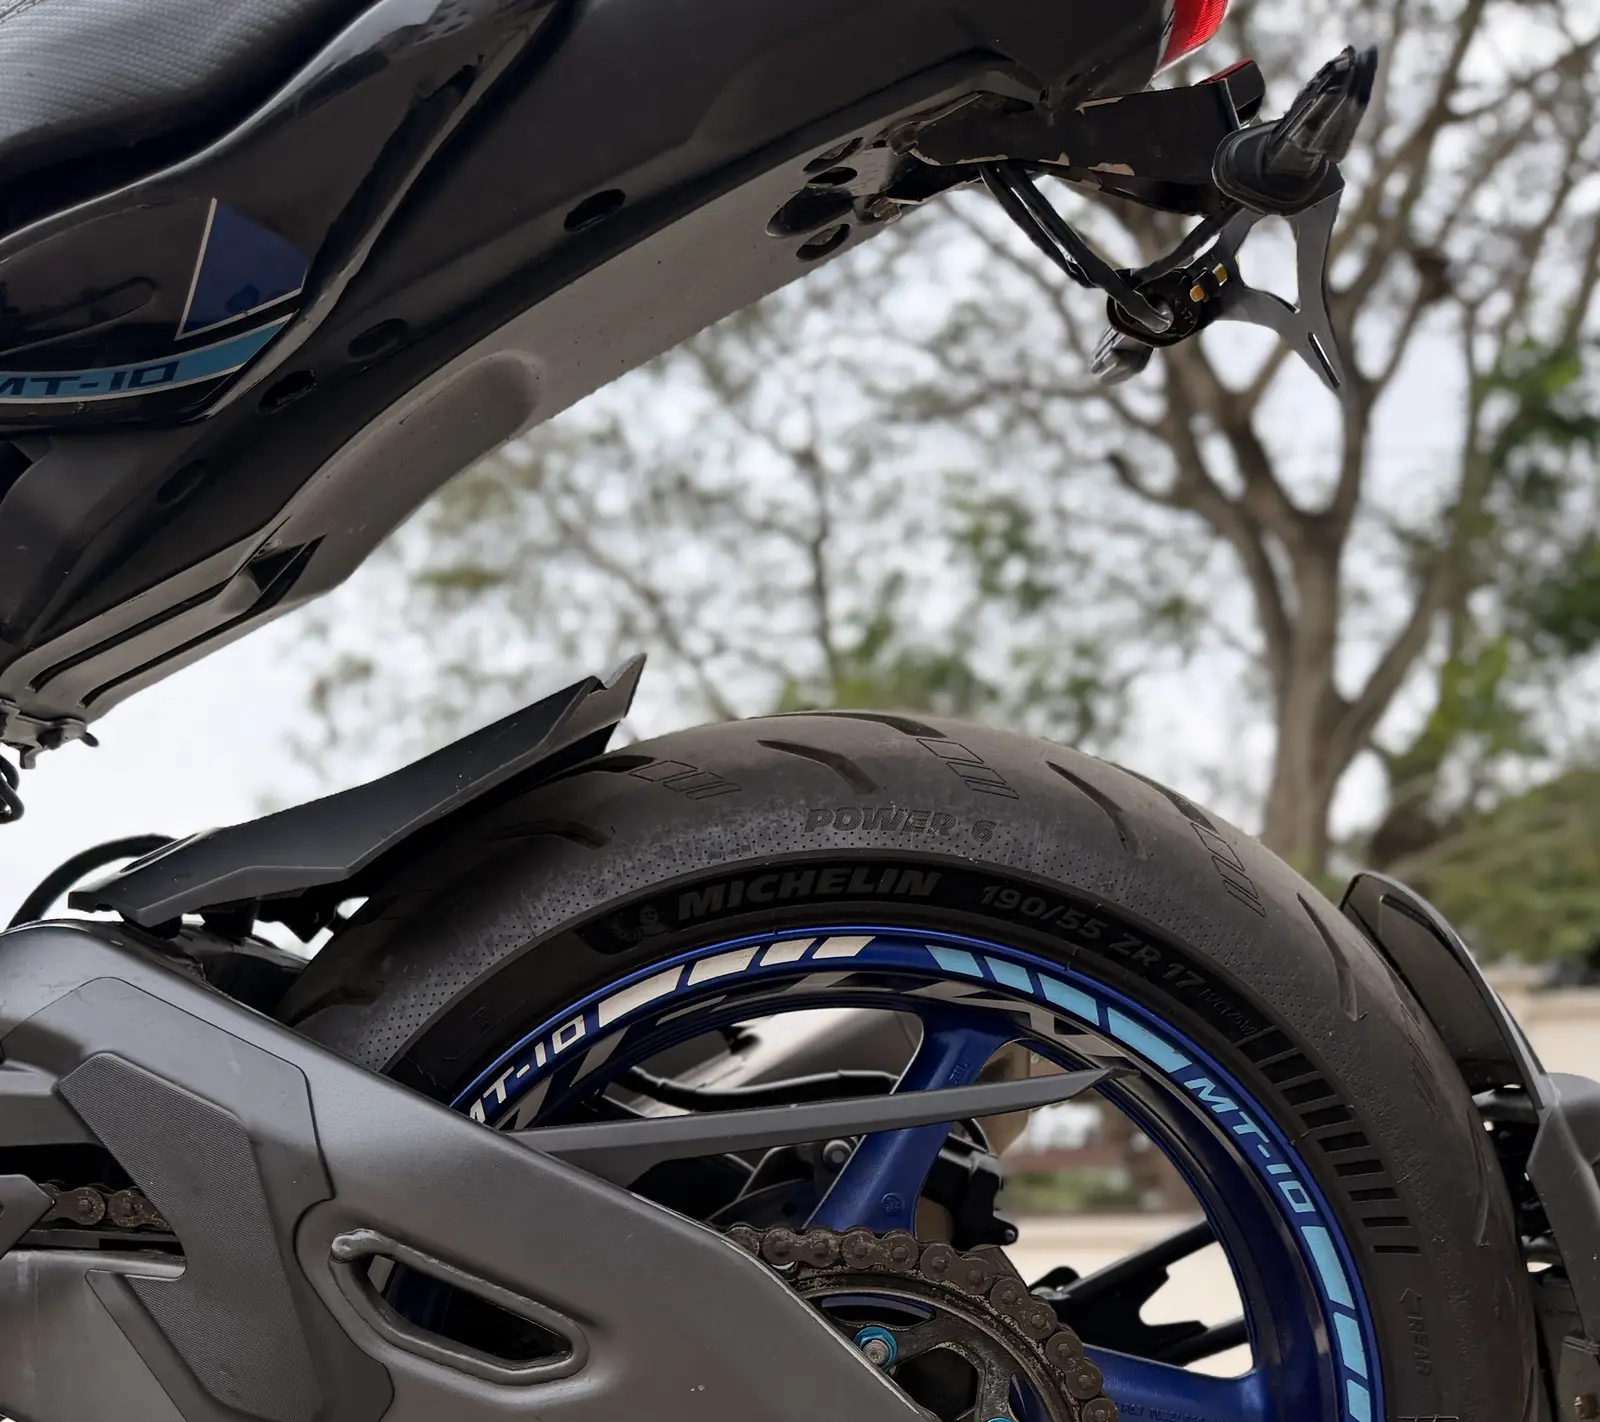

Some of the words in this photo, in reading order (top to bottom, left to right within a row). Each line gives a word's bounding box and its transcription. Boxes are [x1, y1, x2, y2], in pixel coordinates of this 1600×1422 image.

[804, 806, 958, 838] POWER
[970, 818, 996, 844] 6
[677, 866, 942, 922] MICHELIN
[981, 885, 1110, 940] 190/55
[1109, 931, 1164, 969] ZR
[1168, 961, 1208, 990] 17
[1184, 1077, 1317, 1213] MT-10
[1406, 1314, 1433, 1377] REAR
